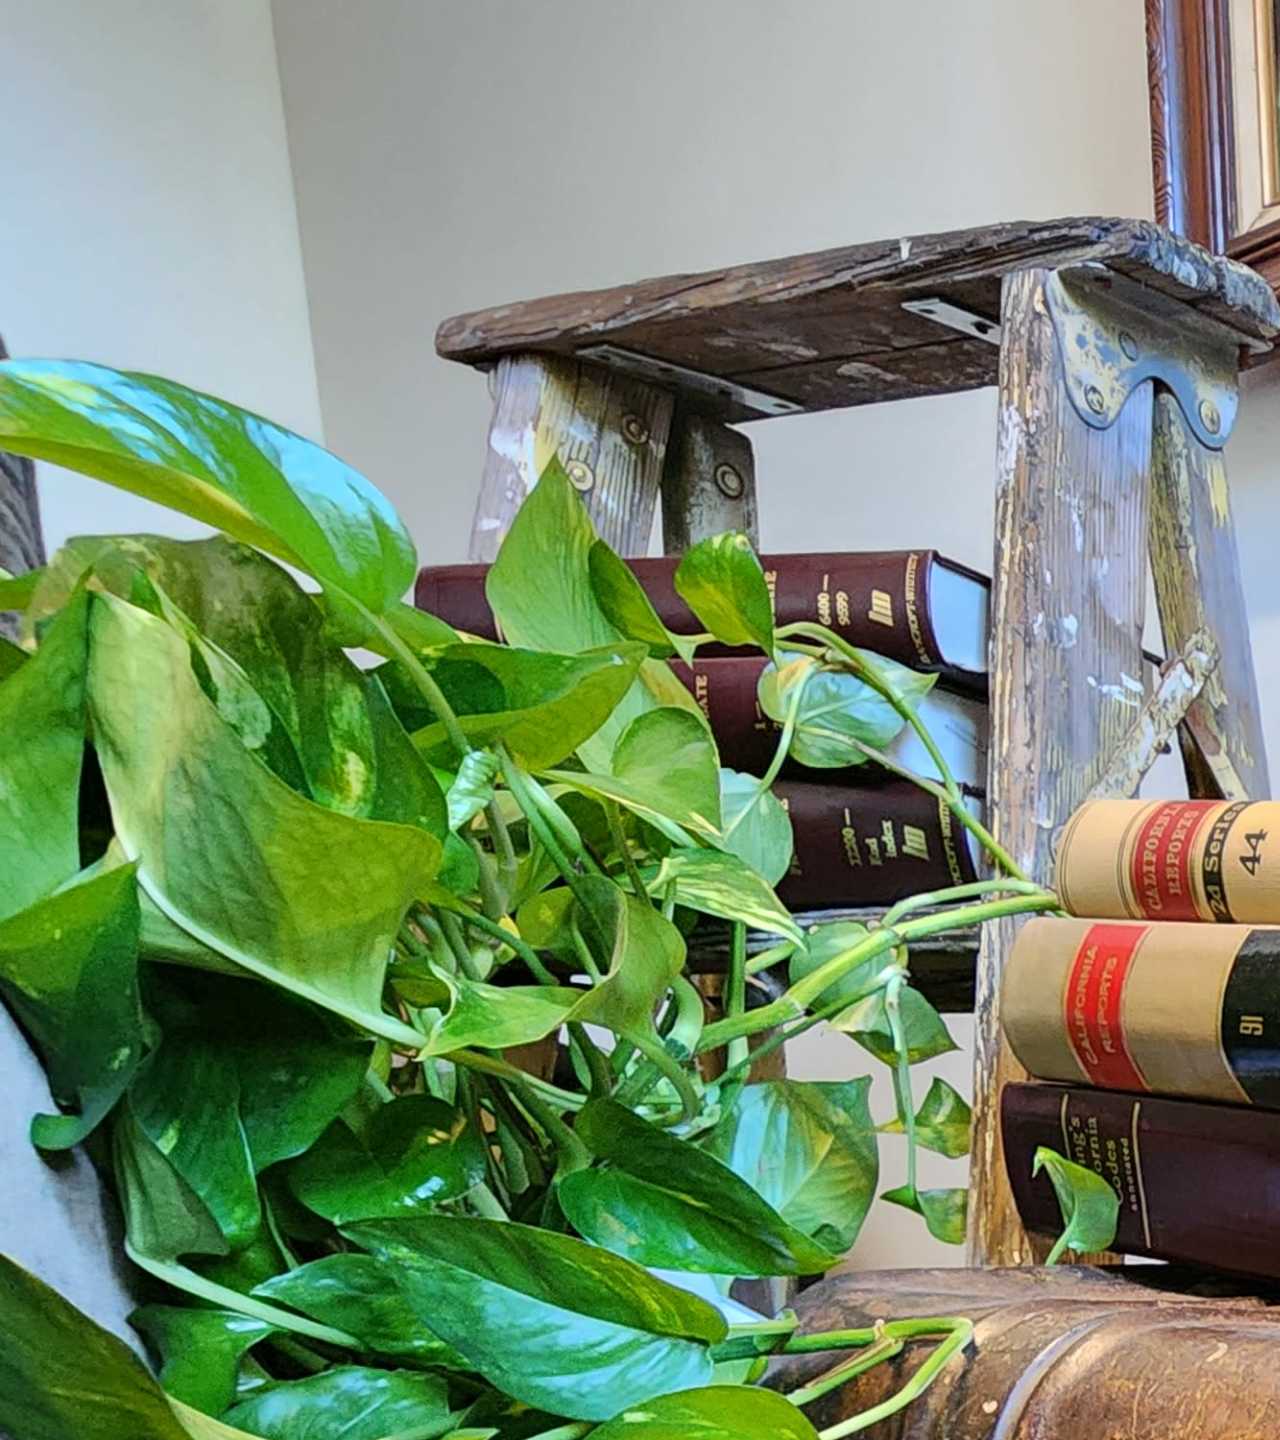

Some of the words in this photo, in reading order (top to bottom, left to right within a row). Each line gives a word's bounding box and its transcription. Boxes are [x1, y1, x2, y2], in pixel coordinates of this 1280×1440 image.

[1143, 803, 1181, 910] CALIFORNI
[1166, 809, 1199, 895] REPORTS
[1239, 829, 1267, 877] 44
[1207, 885, 1226, 914] 2d
[1070, 945, 1099, 1065] CALIFORNIA
[1097, 956, 1118, 1055] REPORTS
[1239, 1015, 1263, 1036] 91
[1120, 1138, 1138, 1211] annotated
